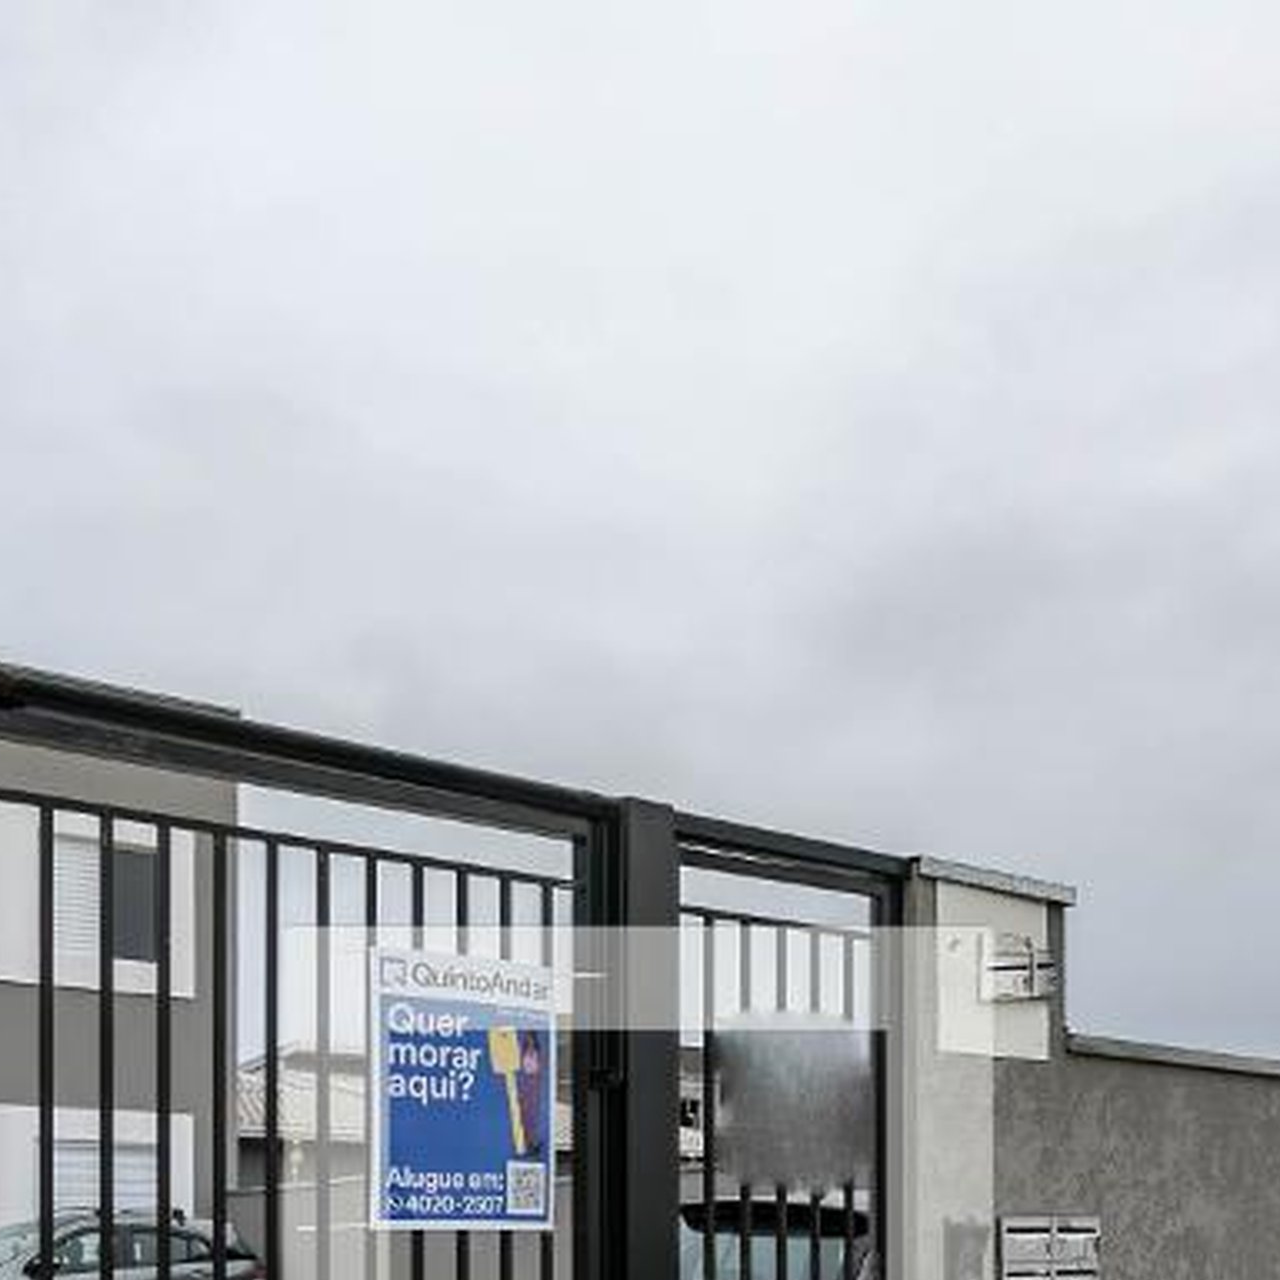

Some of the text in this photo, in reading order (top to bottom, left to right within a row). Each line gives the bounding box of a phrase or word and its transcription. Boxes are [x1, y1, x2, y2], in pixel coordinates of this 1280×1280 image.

[412, 961, 550, 1000] QuintoAndar
[389, 1003, 469, 1037] Quer
[389, 1044, 481, 1070] morar
[389, 1069, 474, 1106] aqui?
[385, 1166, 465, 1194] Alugue
